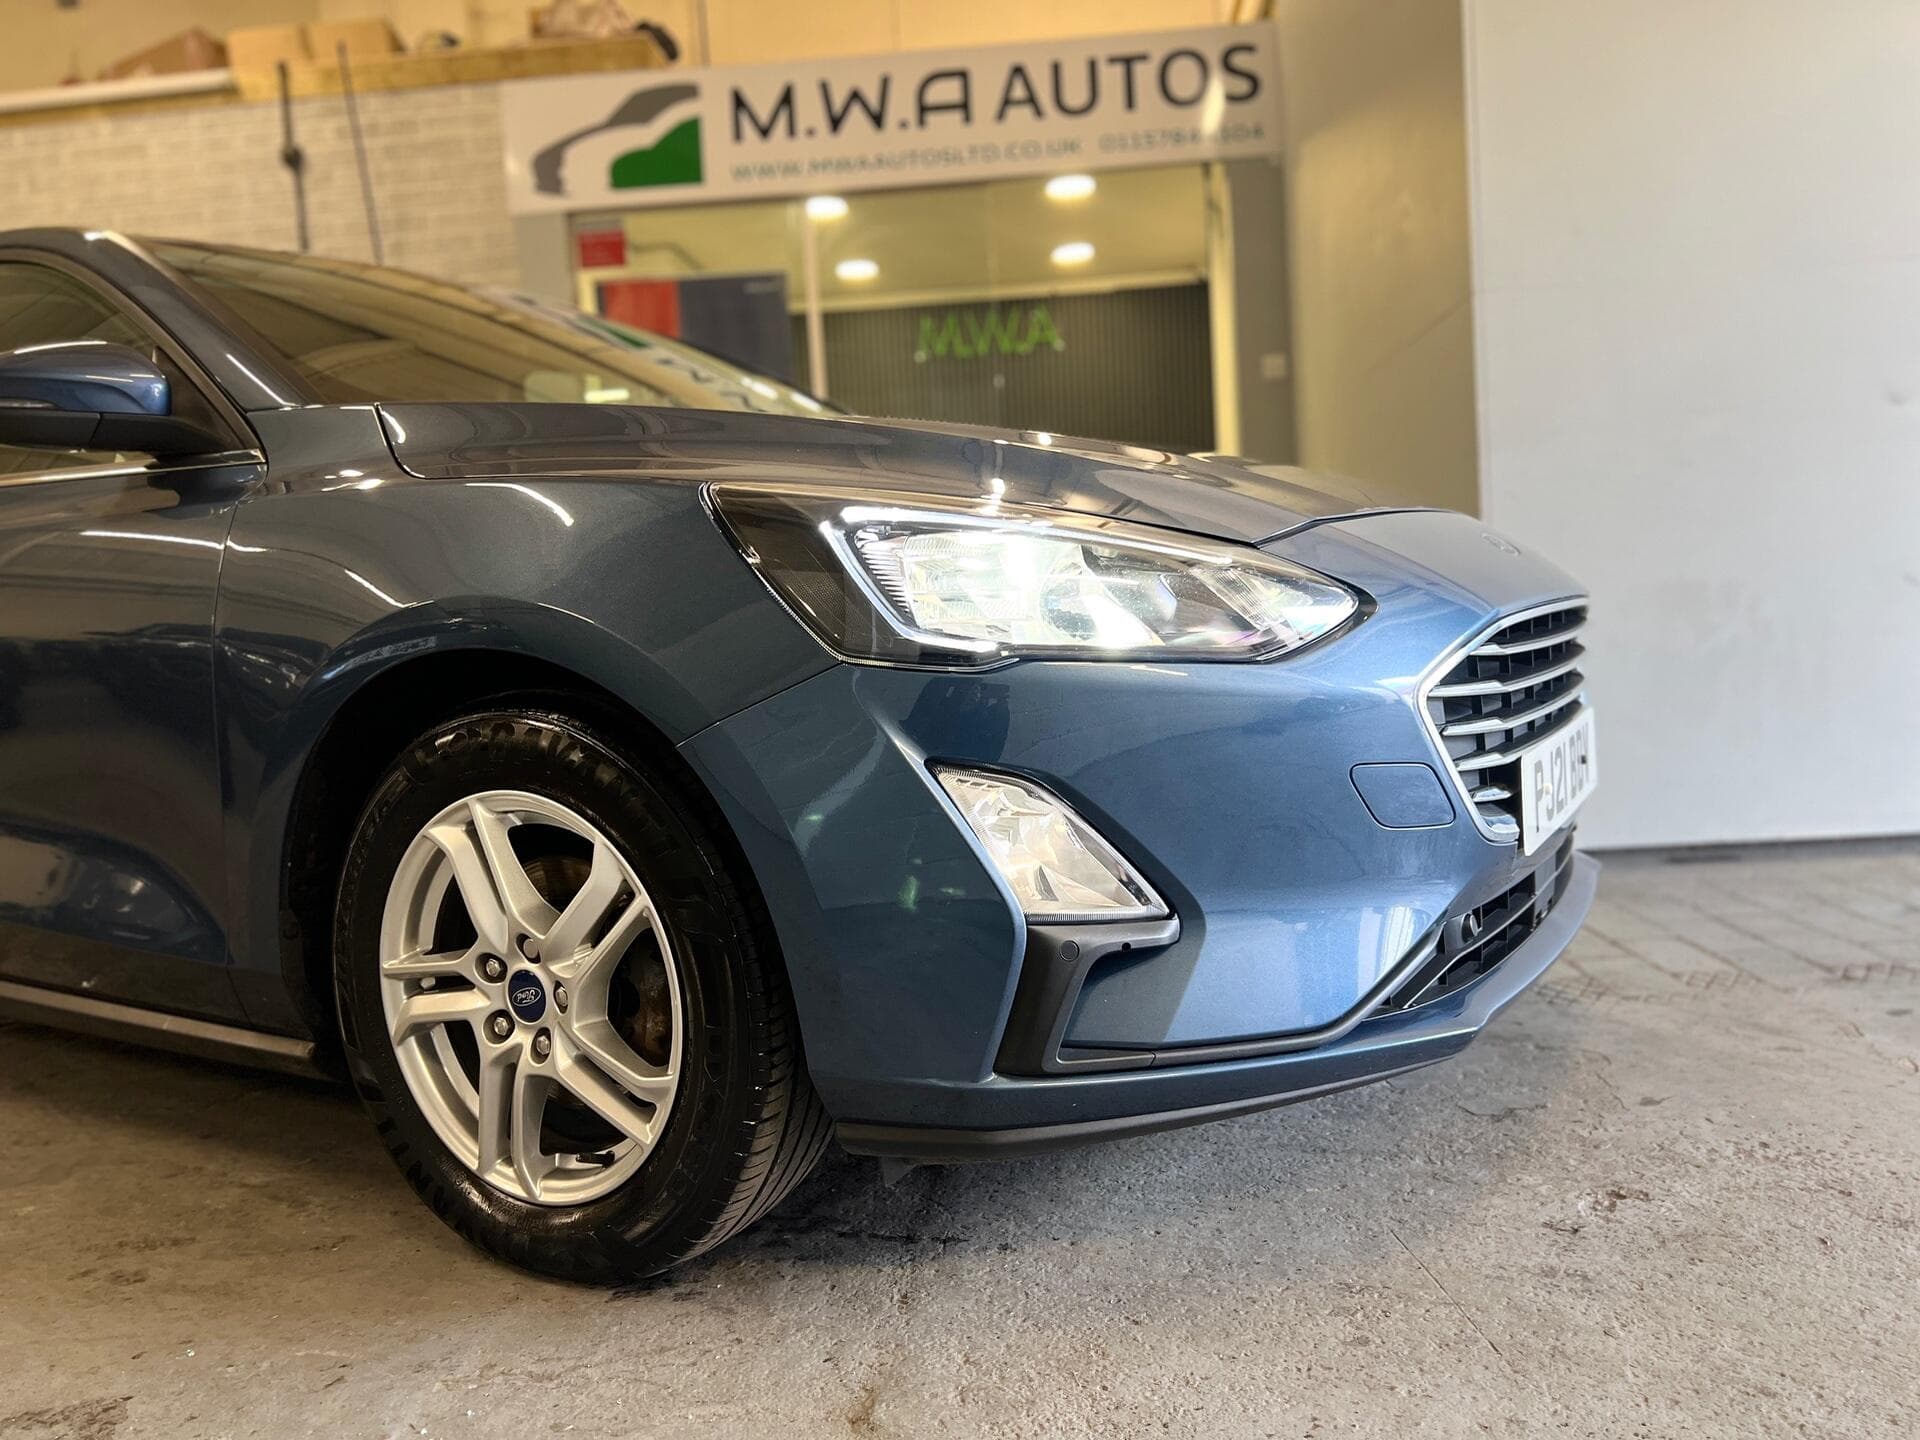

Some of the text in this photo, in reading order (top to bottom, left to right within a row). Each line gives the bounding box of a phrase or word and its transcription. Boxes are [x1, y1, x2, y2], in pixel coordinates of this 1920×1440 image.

[731, 44, 1262, 143] M.W.A AUTOS
[918, 304, 1058, 358] MWA
[1534, 742, 1568, 833] PJ21
